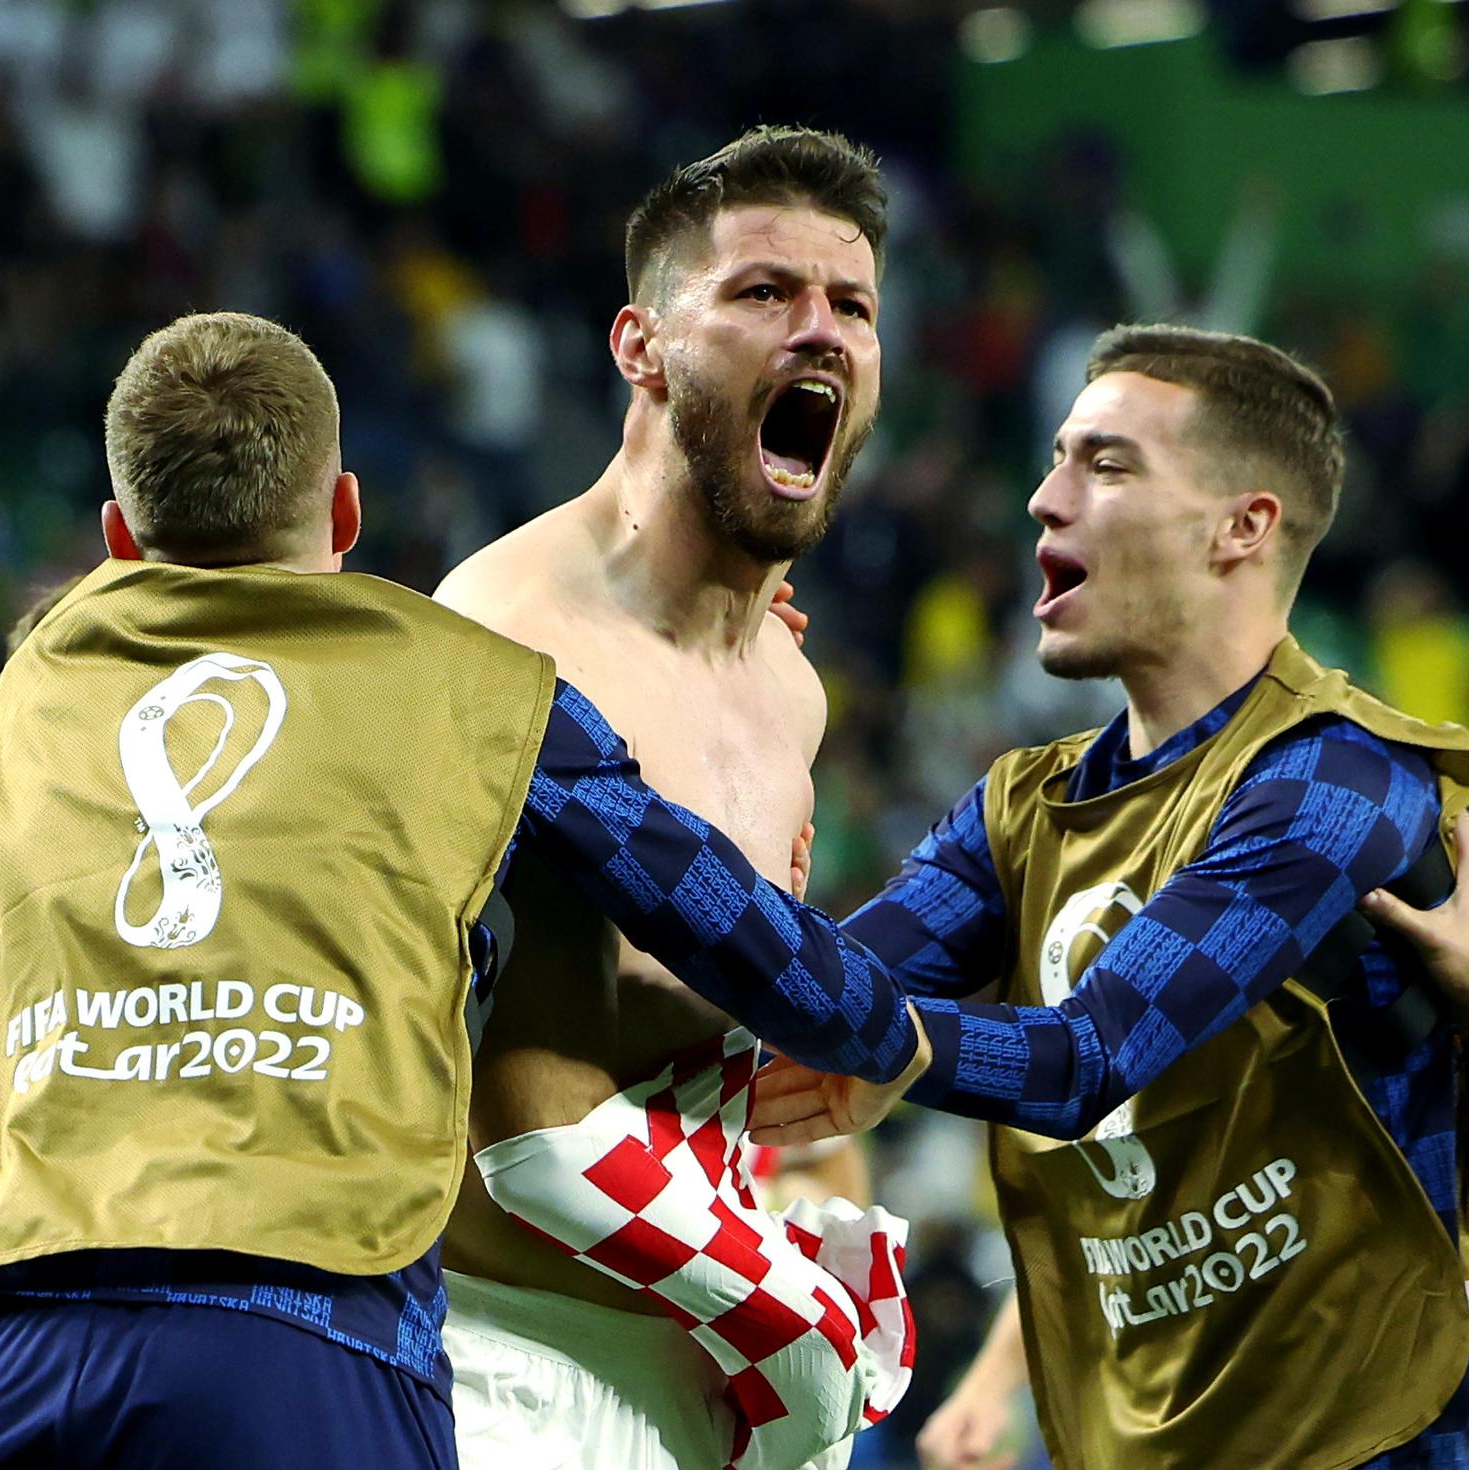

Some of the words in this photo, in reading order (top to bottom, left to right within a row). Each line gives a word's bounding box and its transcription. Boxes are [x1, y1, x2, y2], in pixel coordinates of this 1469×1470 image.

[6, 988, 68, 1057] FIFA
[75, 979, 254, 1029] WORLD
[263, 983, 365, 1033] CUP
[1213, 1158, 1296, 1230] CUP
